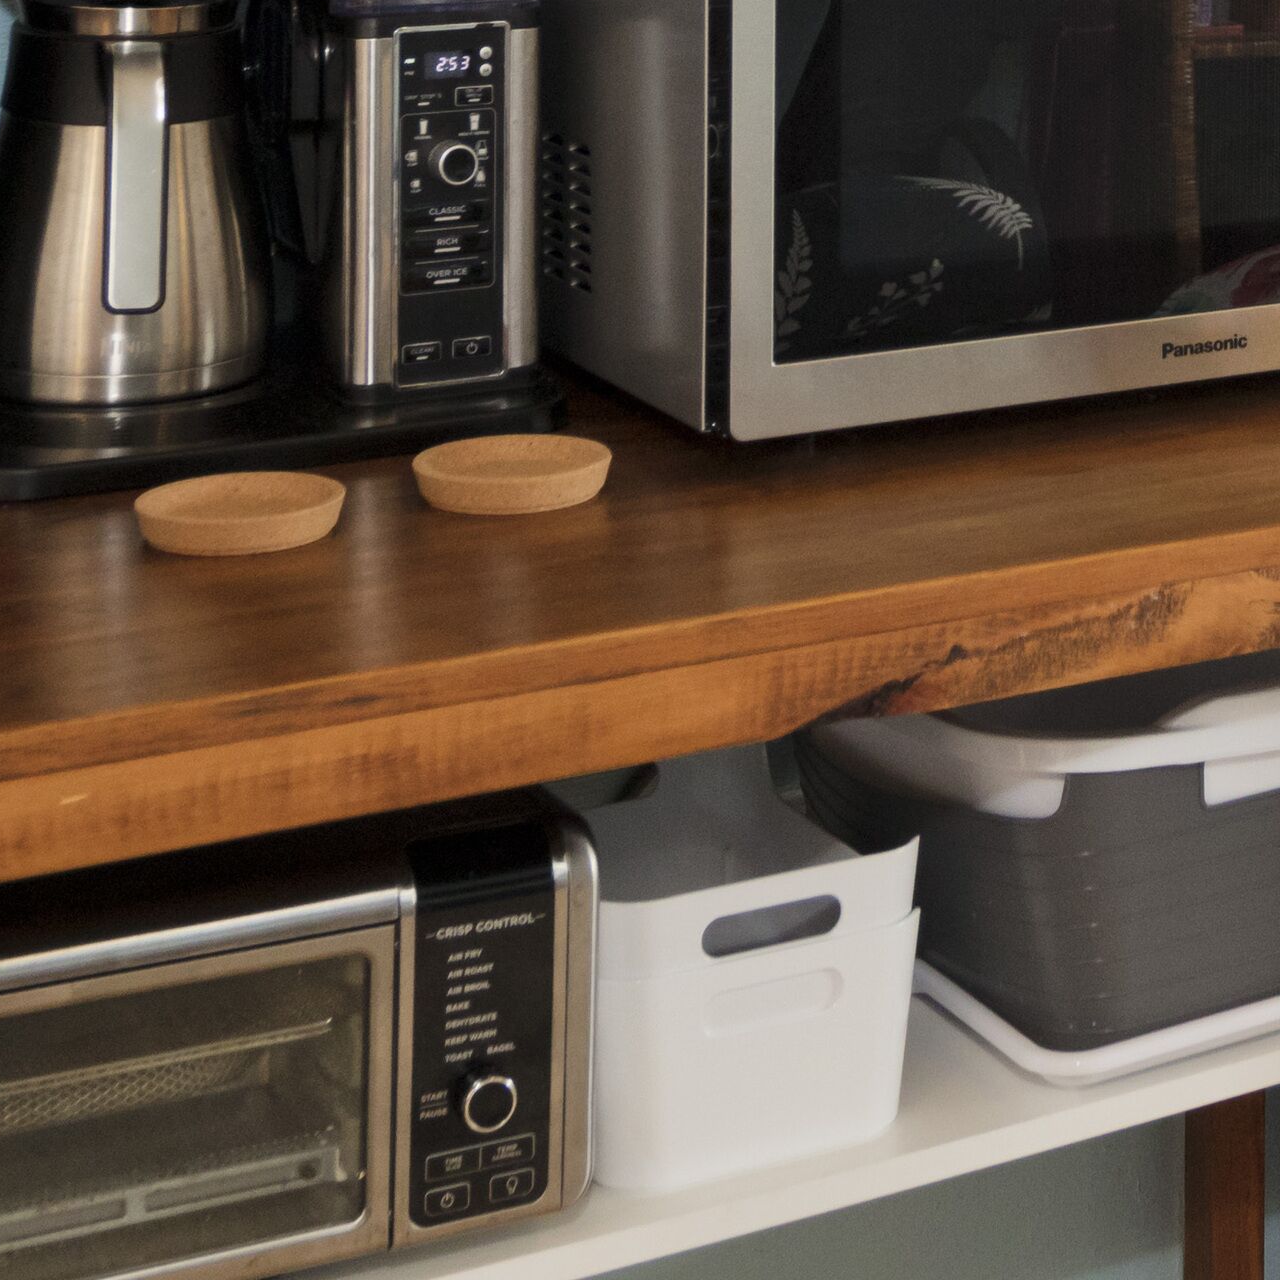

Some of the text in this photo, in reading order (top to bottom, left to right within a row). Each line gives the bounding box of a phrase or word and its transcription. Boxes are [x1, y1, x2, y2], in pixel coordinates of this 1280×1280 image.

[428, 205, 466, 216] CLASSIC
[436, 238, 458, 246] RICH
[426, 267, 468, 279] OVER ICE
[1161, 334, 1248, 359] Panasonic
[436, 912, 536, 940] CRISP CONTROL
[447, 948, 483, 963] AIR FRY
[447, 962, 495, 980] AIR ROAST
[446, 980, 491, 997] AIR BROIL
[445, 1001, 471, 1014] BAKE
[445, 1011, 498, 1031] DEHYDRATE
[445, 1028, 498, 1048] KEEP WARM
[445, 1041, 516, 1063] TOAST BAGEL
[420, 1089, 448, 1103] START
[420, 1107, 448, 1120] PAUSE
